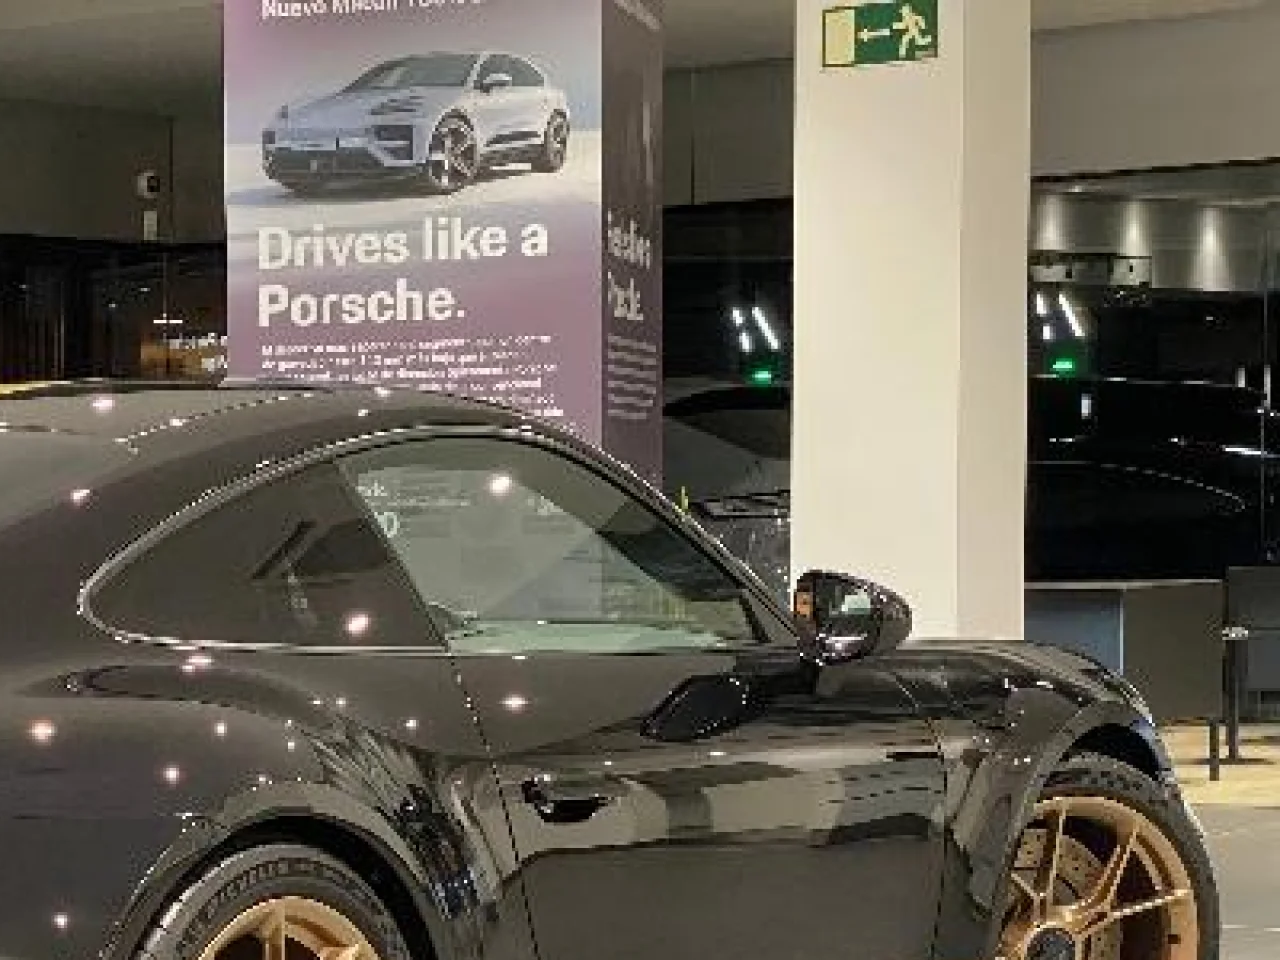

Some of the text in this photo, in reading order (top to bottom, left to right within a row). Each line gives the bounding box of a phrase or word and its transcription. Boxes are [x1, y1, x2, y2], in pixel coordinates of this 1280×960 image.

[258, 217, 549, 269] Drives like a
[258, 278, 466, 327] Porsche.
